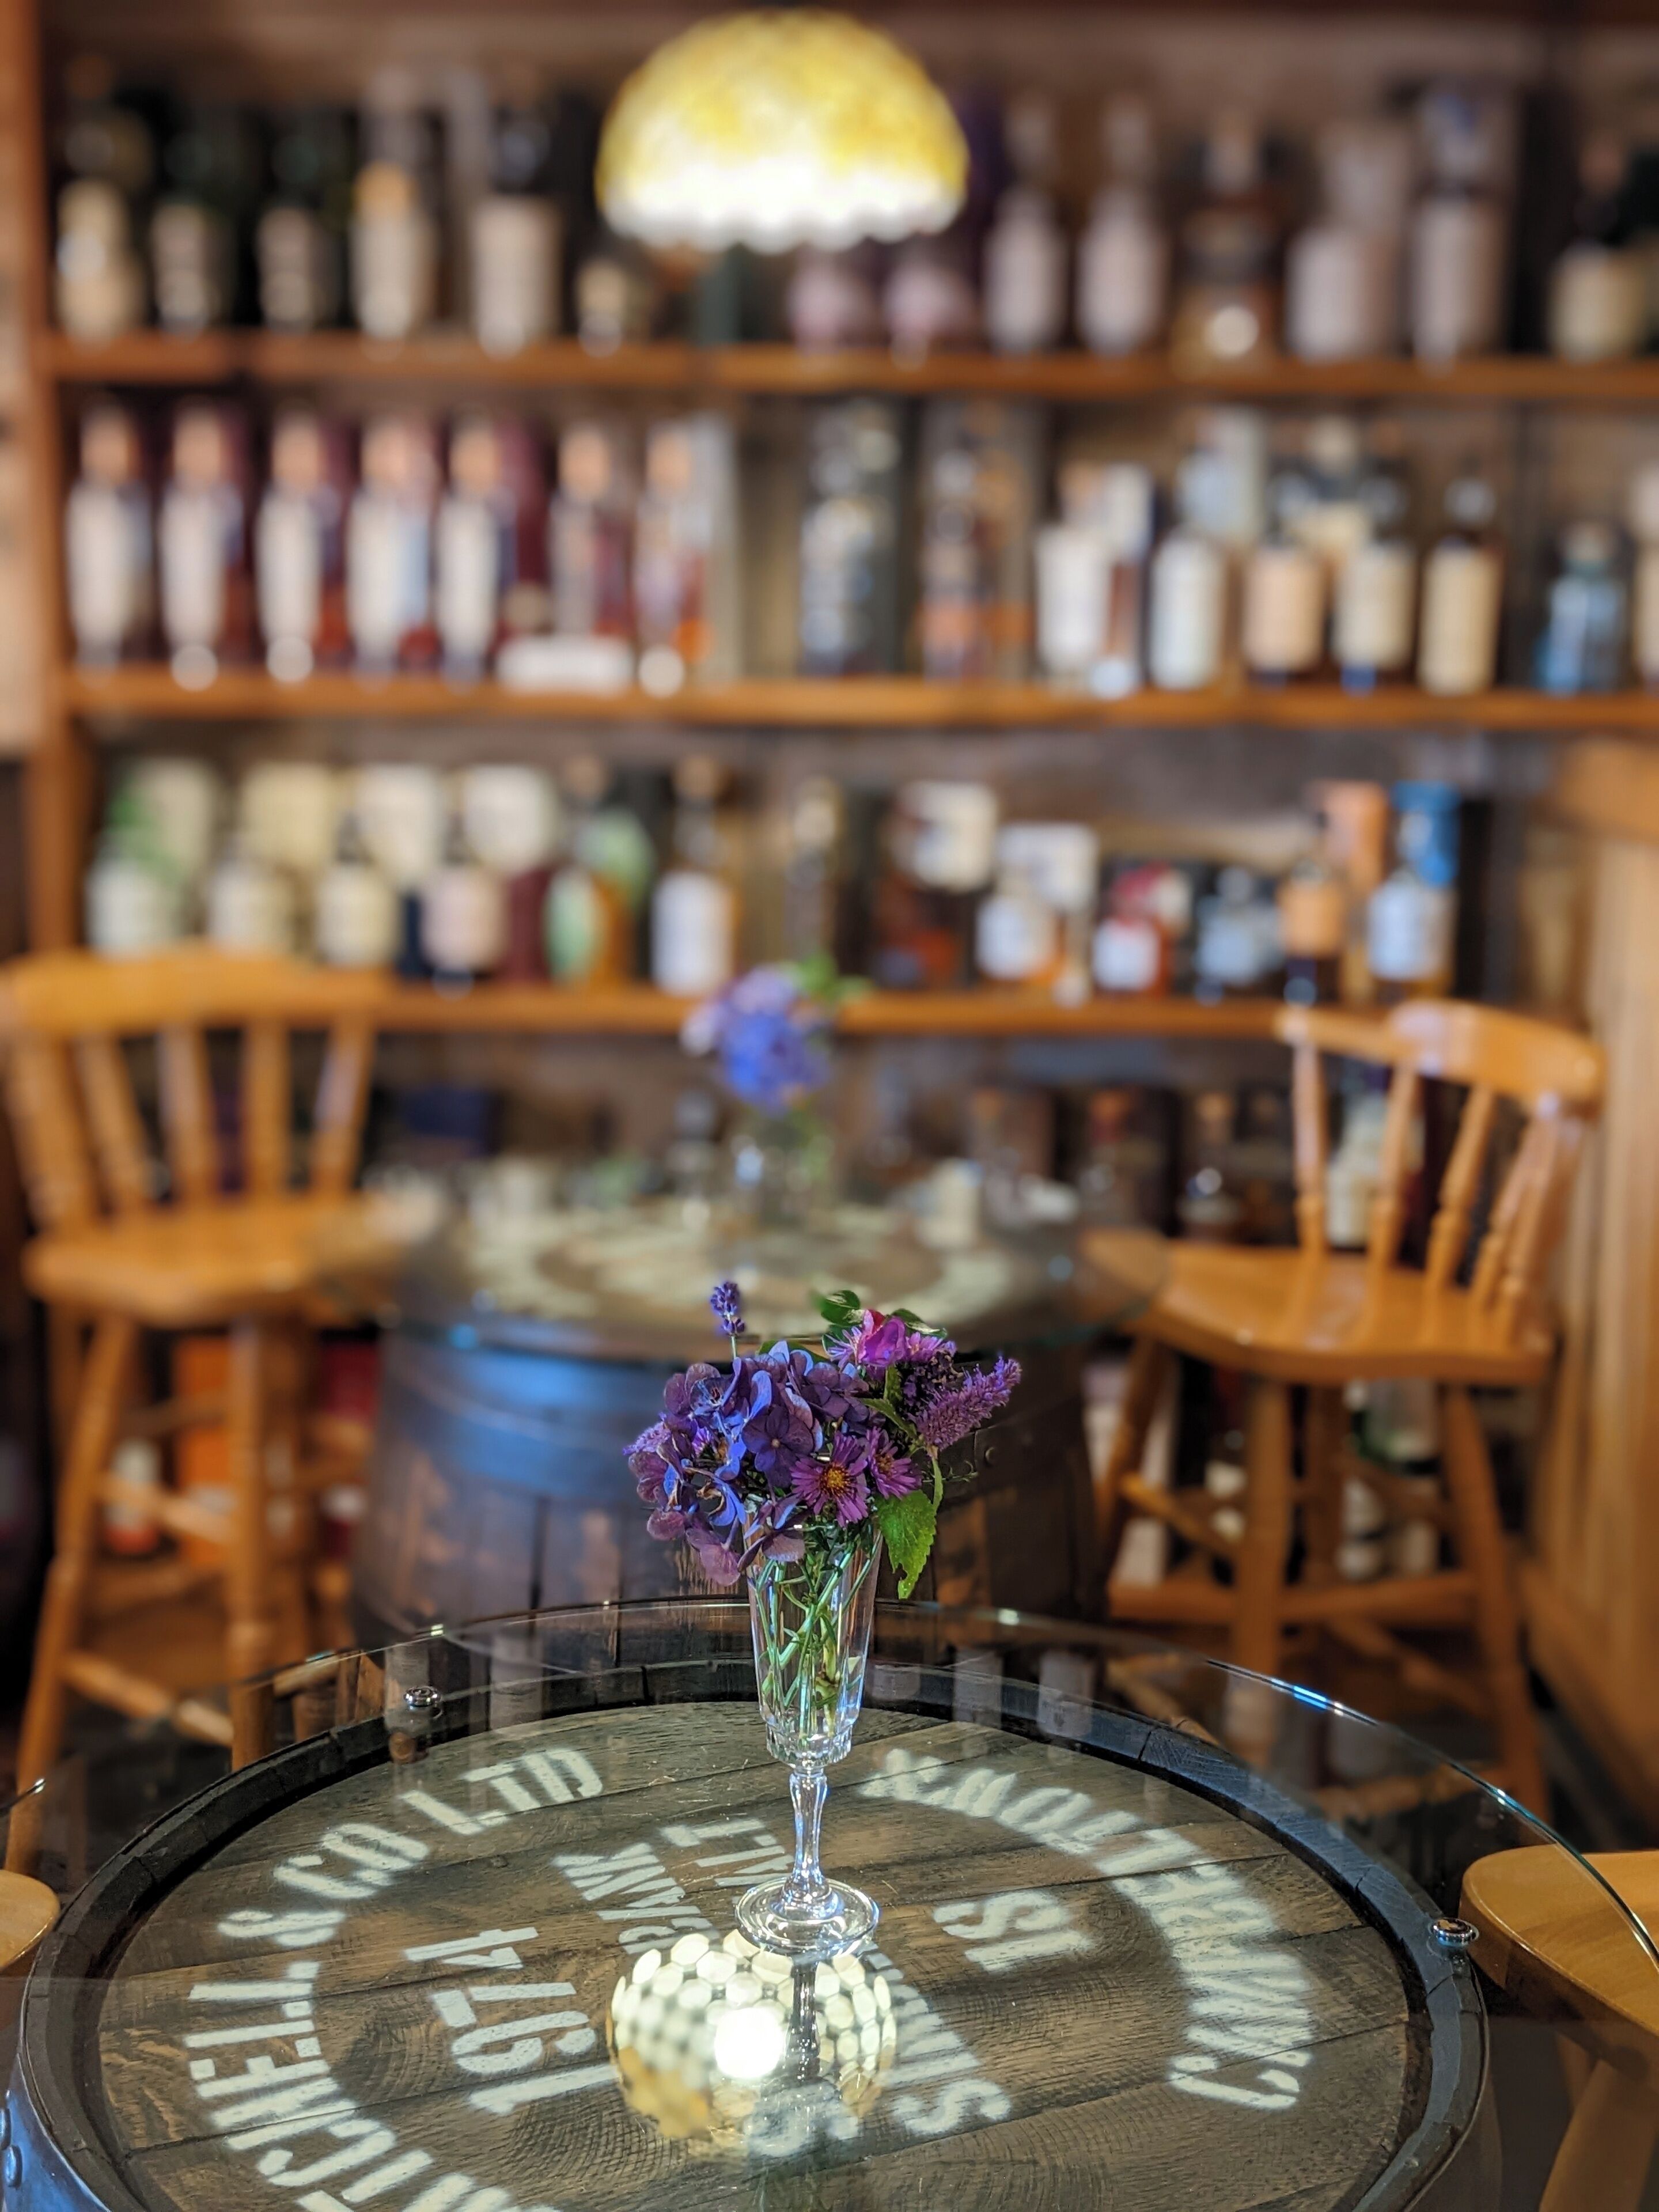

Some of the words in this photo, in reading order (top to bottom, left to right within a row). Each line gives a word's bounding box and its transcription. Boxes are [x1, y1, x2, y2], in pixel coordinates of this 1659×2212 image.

[396, 1748, 604, 1836] LTD
[272, 1822, 431, 1899] CO
[217, 1909, 344, 1947] &
[402, 1926, 620, 2116] 1974
